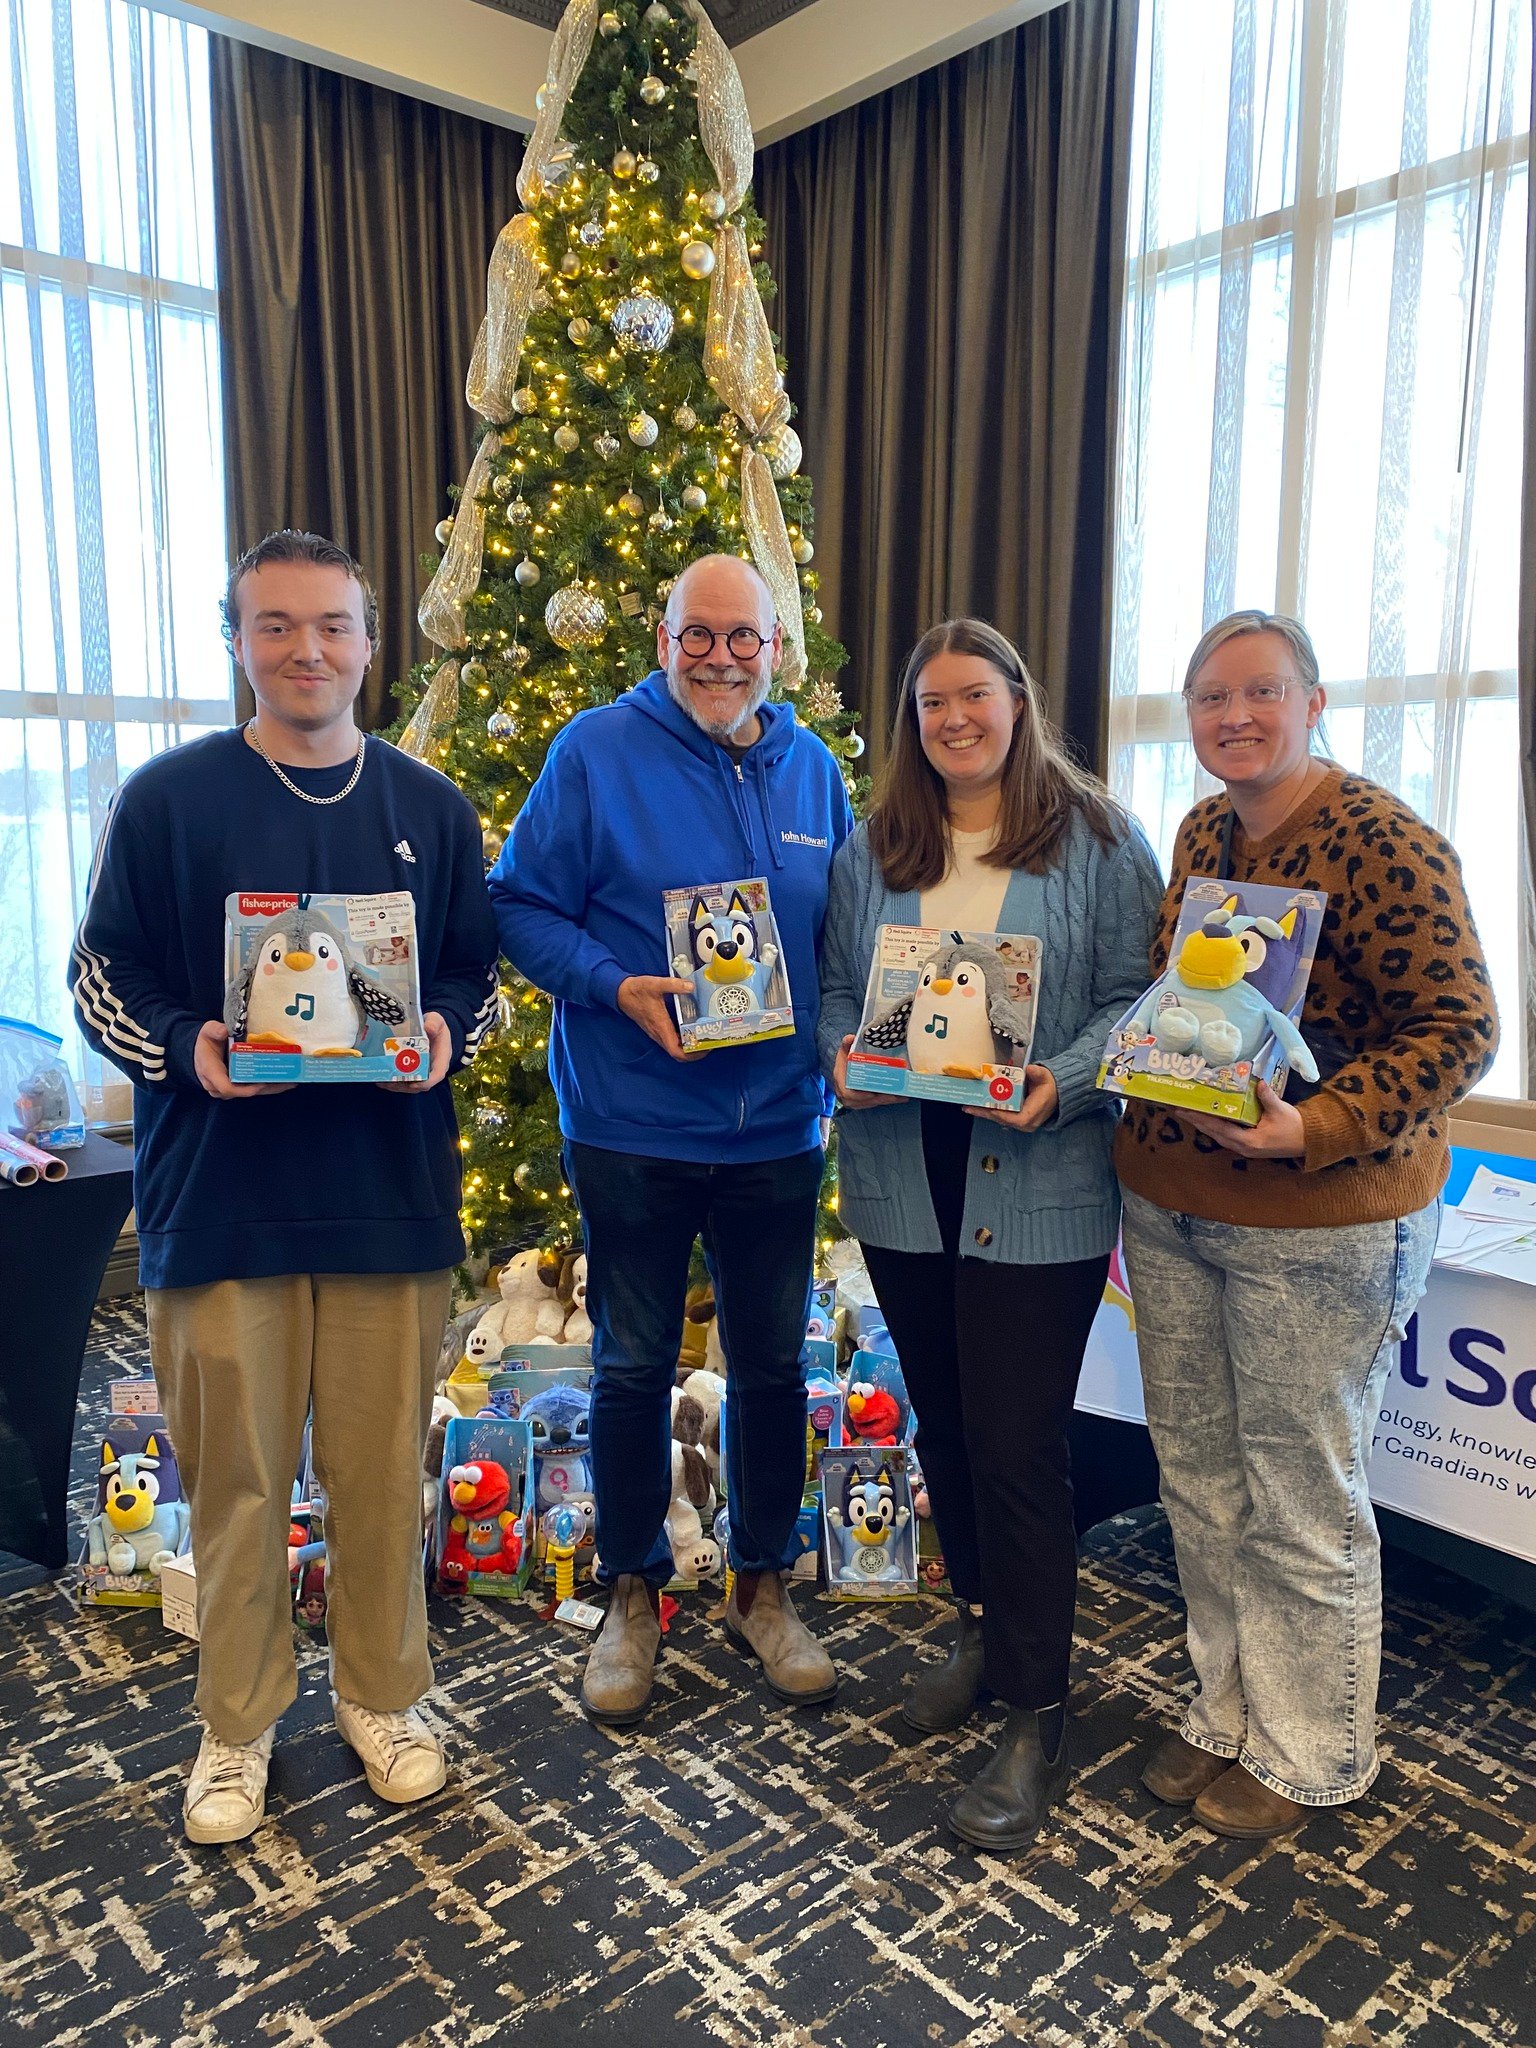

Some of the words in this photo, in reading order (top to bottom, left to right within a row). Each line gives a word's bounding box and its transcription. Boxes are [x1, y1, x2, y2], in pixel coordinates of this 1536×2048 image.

[781, 831, 800, 842] John
[801, 833, 828, 846] Howard
[1147, 1050, 1207, 1080] BLUEY
[1385, 1437, 1509, 1492] Canadians
